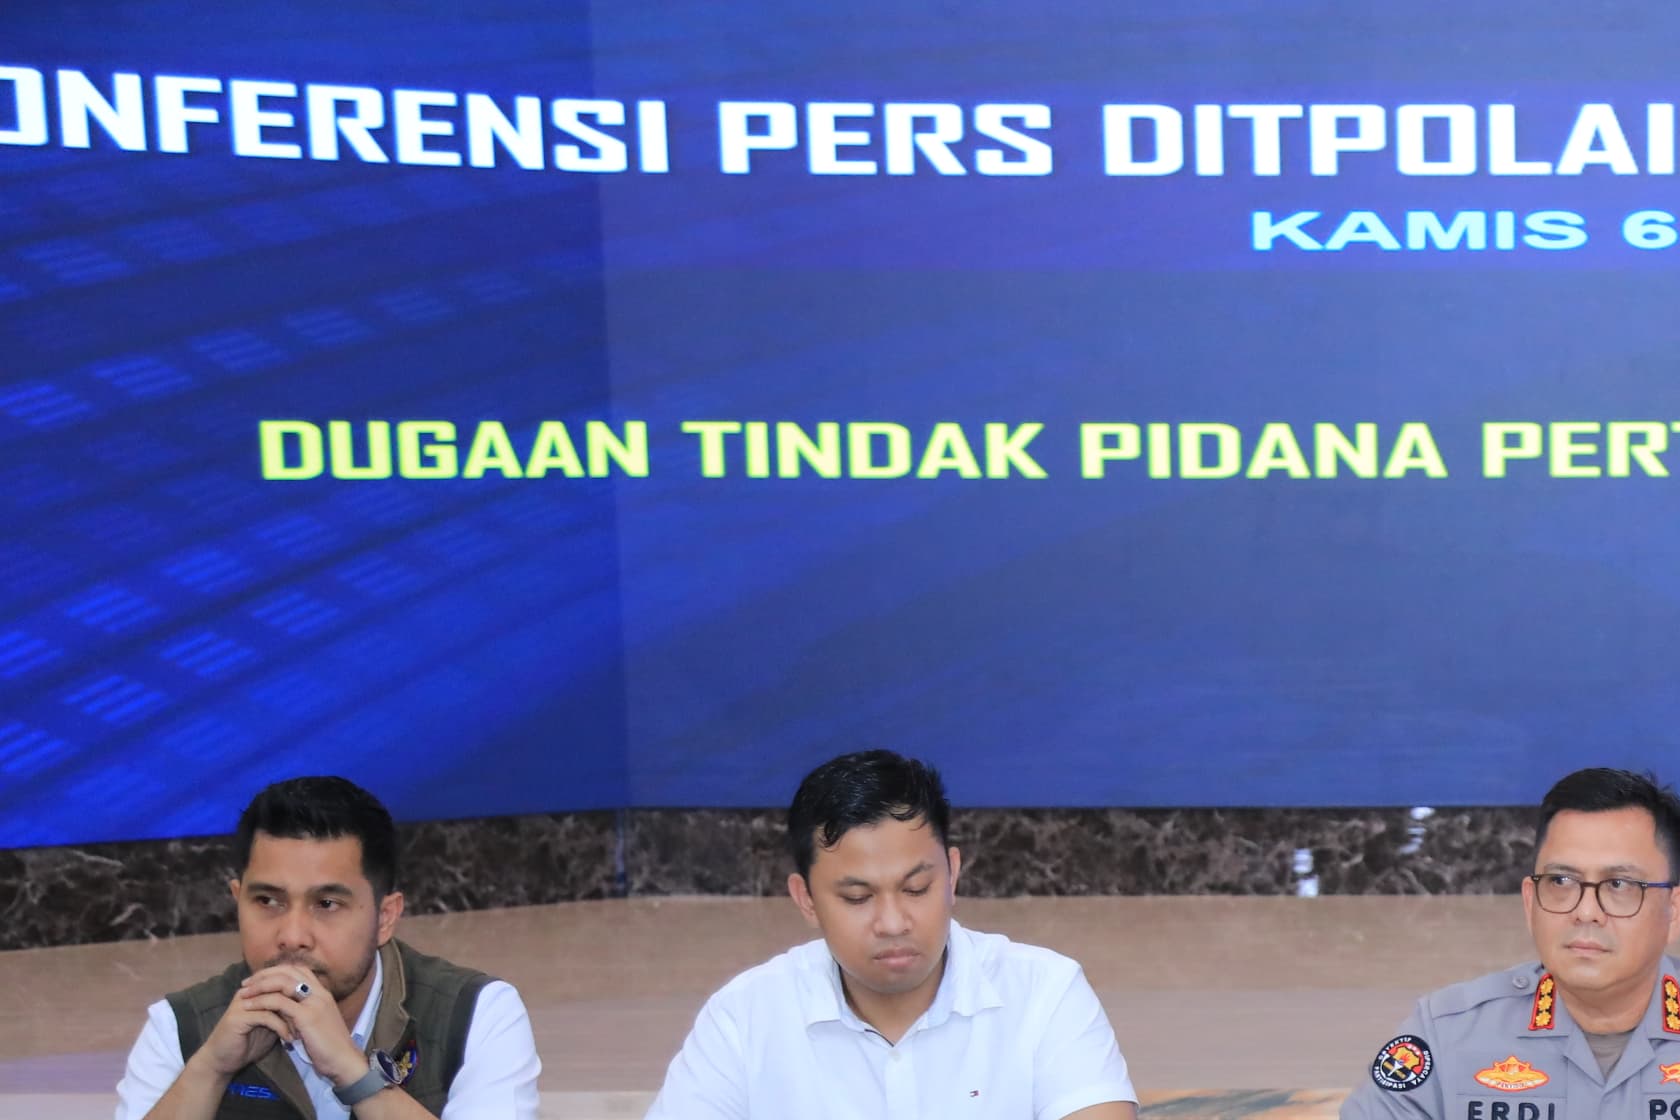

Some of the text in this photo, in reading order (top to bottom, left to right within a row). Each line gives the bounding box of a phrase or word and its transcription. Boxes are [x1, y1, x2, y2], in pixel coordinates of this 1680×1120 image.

[719, 101, 1052, 175] PERS
[1252, 210, 1587, 250] KAMIS
[1622, 210, 1678, 249] 6
[259, 420, 649, 480] DUGAAN
[682, 420, 1047, 479] TINDAK
[1080, 421, 1448, 479] PIDANA
